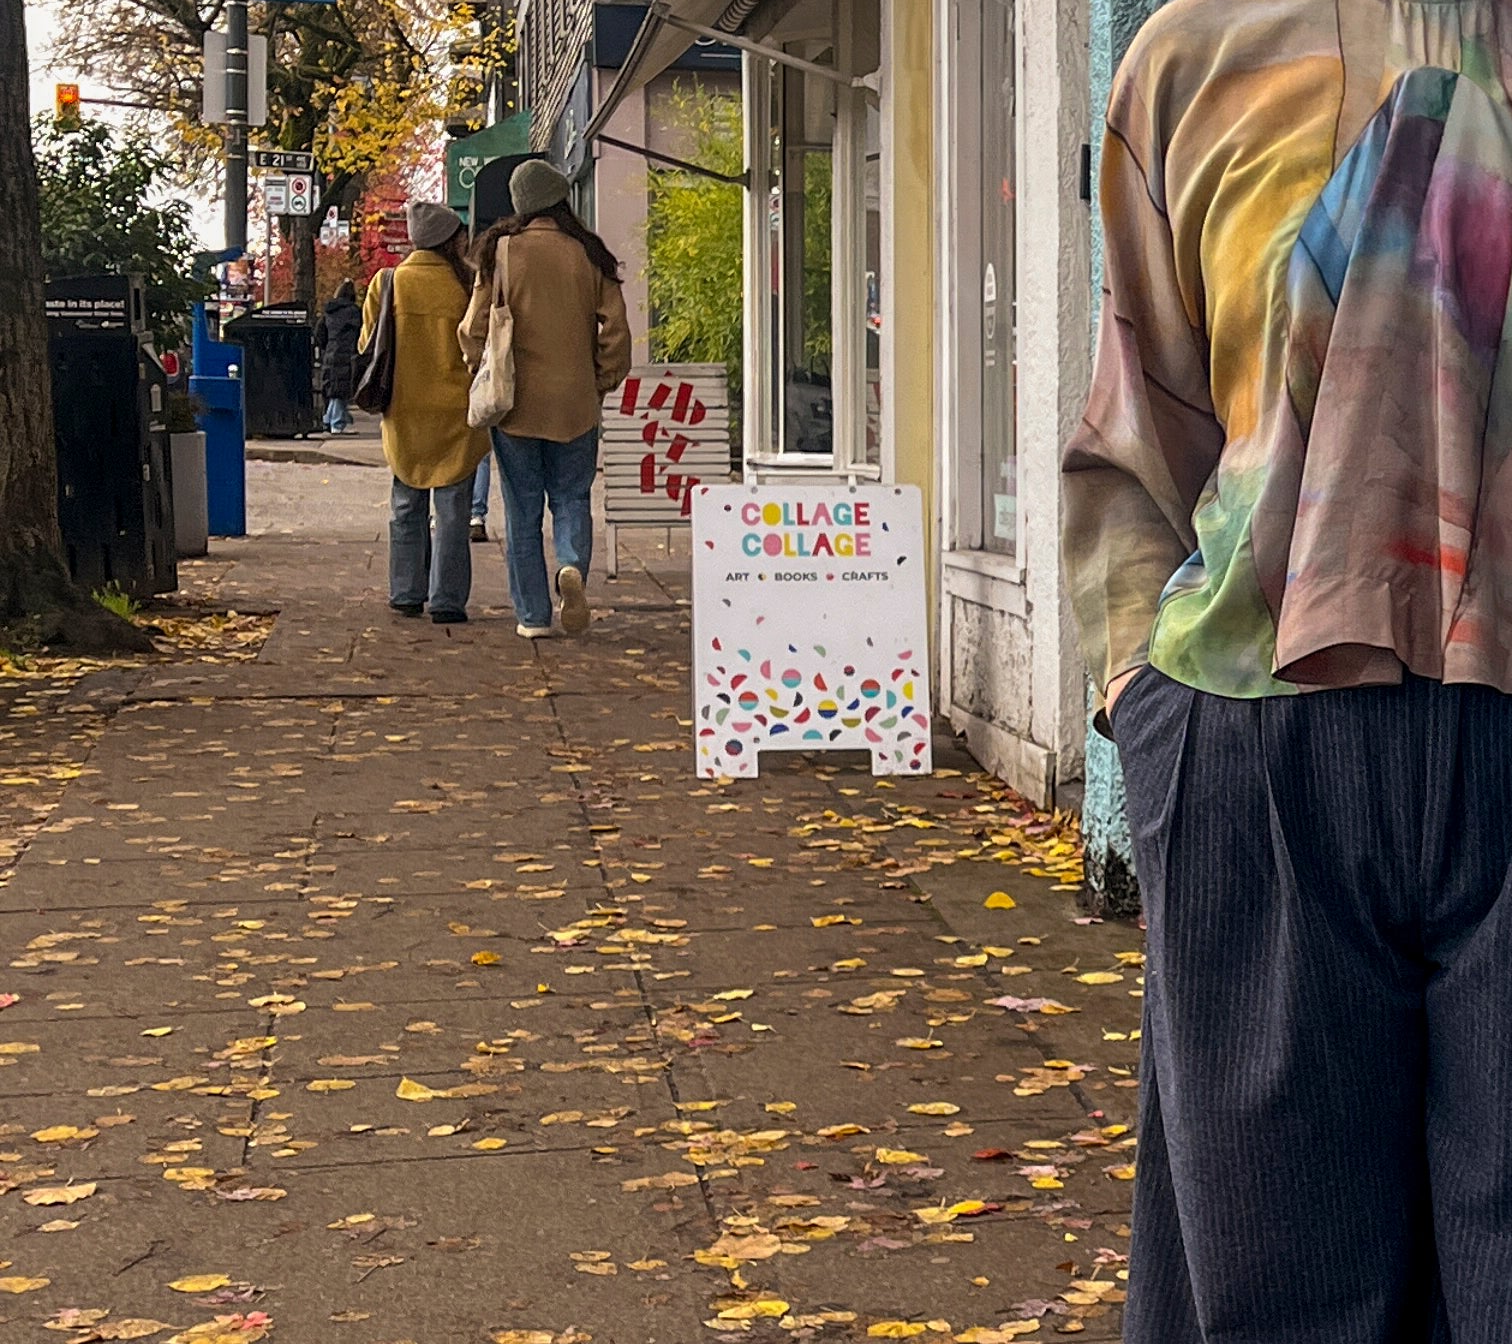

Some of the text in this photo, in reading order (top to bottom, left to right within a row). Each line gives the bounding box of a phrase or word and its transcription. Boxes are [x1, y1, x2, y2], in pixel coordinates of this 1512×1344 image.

[260, 153, 268, 166] E
[67, 300, 78, 308] in
[79, 300, 92, 308] its
[94, 299, 125, 309] place!
[741, 502, 871, 526] COLLAGE
[742, 532, 872, 557] COLLAGE
[725, 571, 889, 582] ART BOOKS CRAFTS
